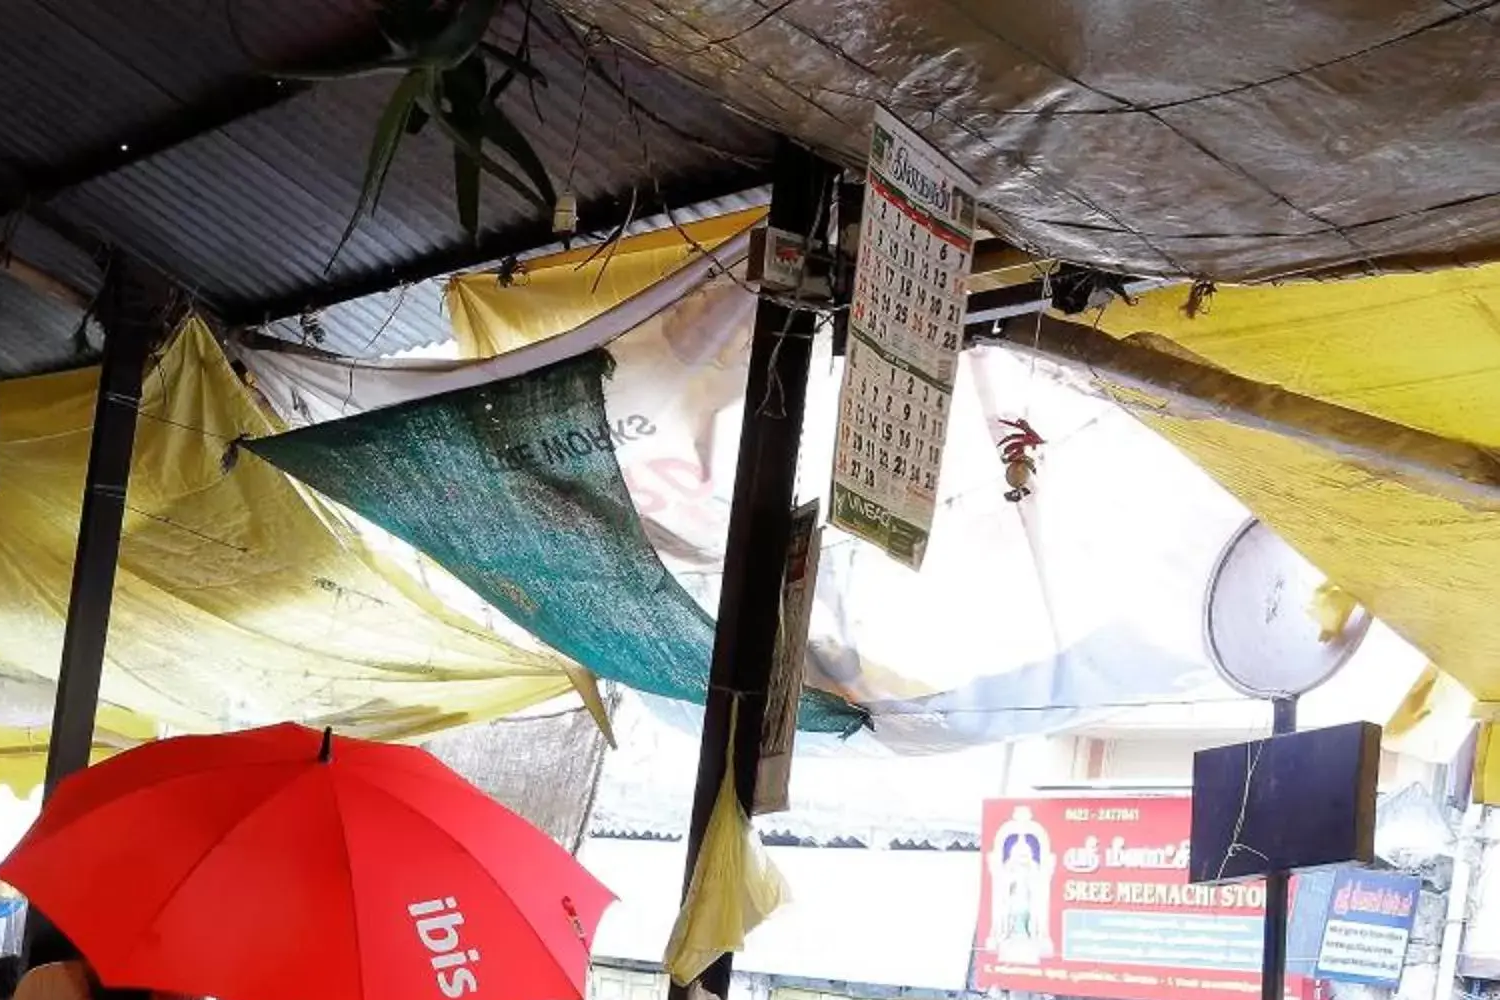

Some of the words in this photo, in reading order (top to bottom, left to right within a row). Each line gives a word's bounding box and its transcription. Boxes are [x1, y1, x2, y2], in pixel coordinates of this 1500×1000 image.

[1064, 880, 1113, 902] SREE
[1117, 882, 1214, 906] MEENACHI
[1220, 884, 1266, 908] STO
[407, 895, 481, 999] ibis
